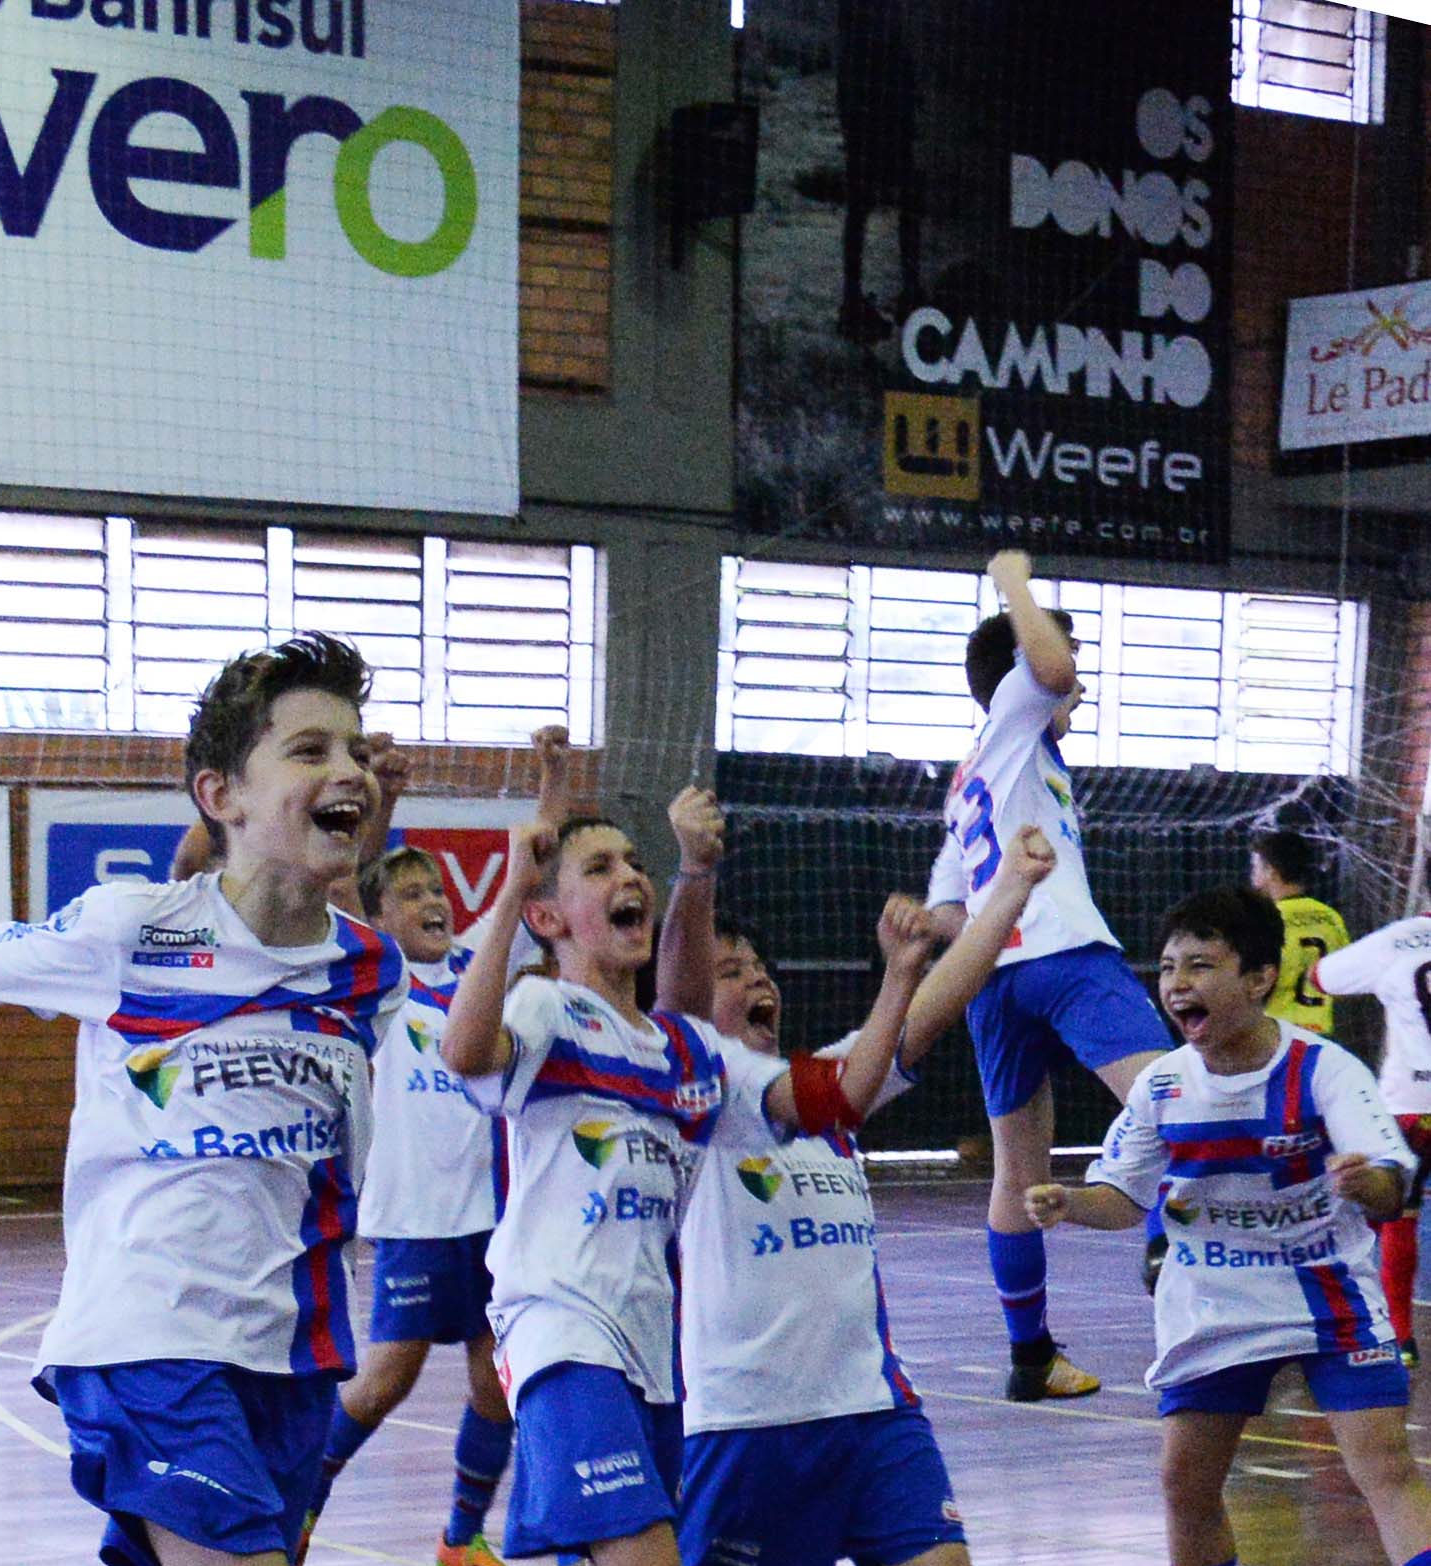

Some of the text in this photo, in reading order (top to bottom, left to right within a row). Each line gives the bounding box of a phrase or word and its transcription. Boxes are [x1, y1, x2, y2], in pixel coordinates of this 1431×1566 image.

[1137, 87, 1214, 163] OS
[1010, 153, 1213, 249] DONOS
[1138, 258, 1213, 323] DO
[901, 306, 1213, 408] CAMPINHO
[1307, 373, 1346, 415] Le
[986, 425, 1203, 494] Weefe
[194, 1108, 339, 1157] Banris
[790, 1217, 875, 1249] Banri
[1205, 1231, 1335, 1267] Banrisul
